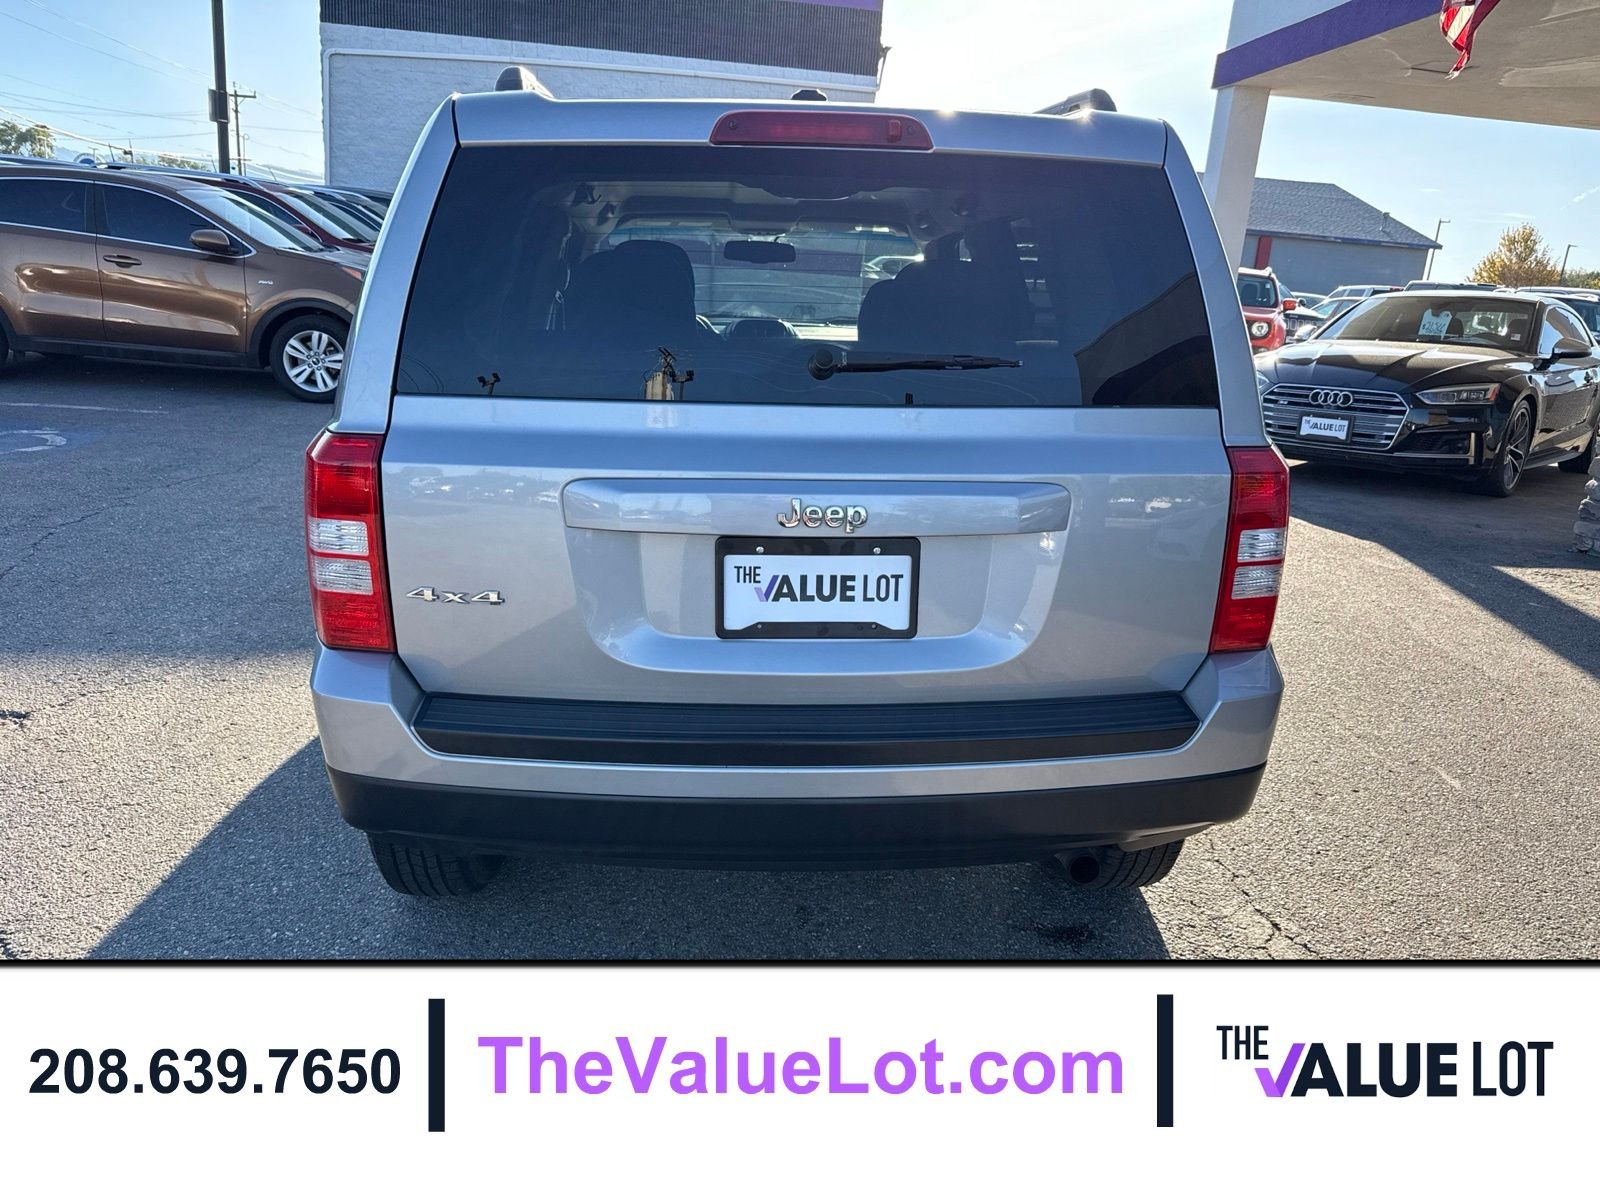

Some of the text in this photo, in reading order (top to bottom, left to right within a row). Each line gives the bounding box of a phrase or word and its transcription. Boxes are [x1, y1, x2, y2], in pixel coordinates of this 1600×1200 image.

[1334, 424, 1346, 432] LOT
[777, 498, 867, 533] Jeep
[406, 586, 505, 605] 4x4
[734, 566, 904, 602] THE VALUE LOT
